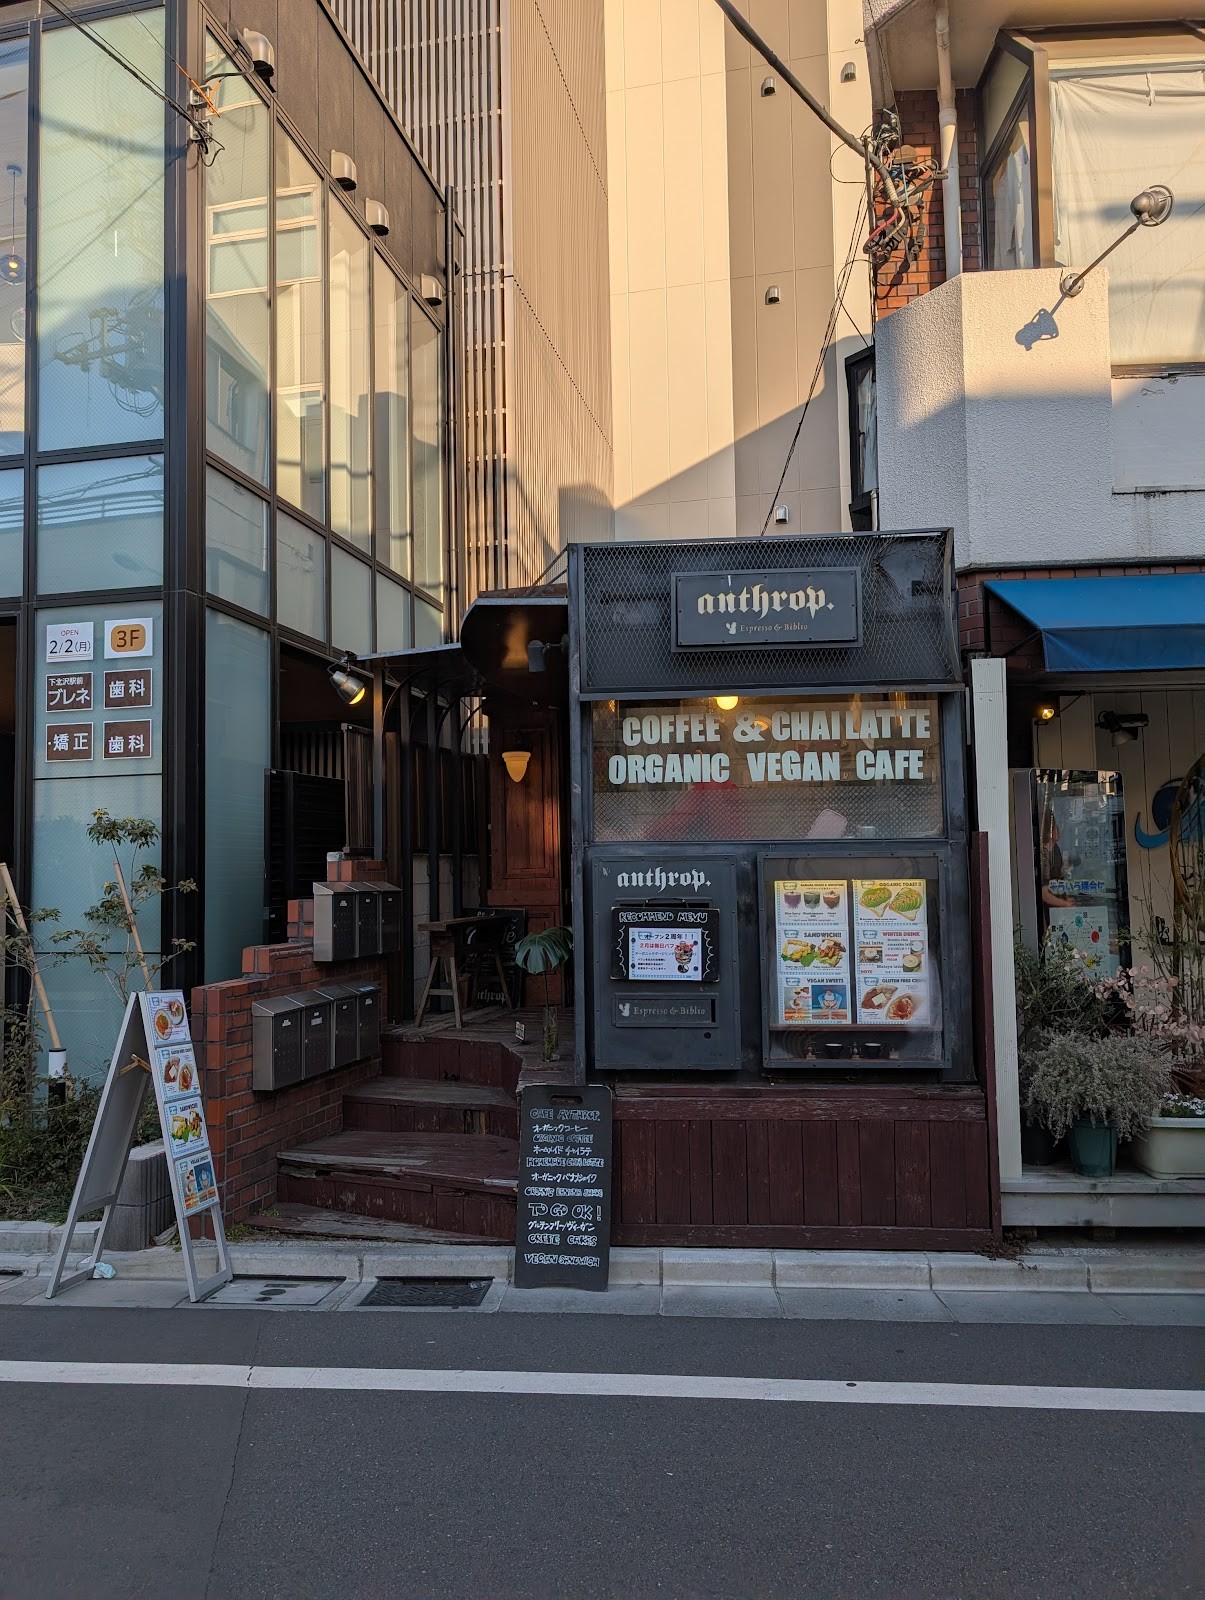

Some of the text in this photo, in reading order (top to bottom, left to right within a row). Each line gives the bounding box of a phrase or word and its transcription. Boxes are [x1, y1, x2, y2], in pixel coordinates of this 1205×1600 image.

[697, 583, 835, 621] anthrop.
[740, 624, 772, 632] Espresso
[784, 623, 808, 631] Biblio
[116, 629, 140, 648] 3F
[49, 639, 91, 654] 2/2(月)
[49, 677, 84, 686] 下北沢駅前
[109, 679, 145, 698] 歯科
[48, 688, 90, 706] ブレネ
[622, 708, 931, 747] COFFEE & CHAI LATTE
[109, 734, 145, 753] 歯科
[608, 749, 924, 784] ORGANIC VEGAN CAFE
[617, 866, 712, 893] anthrop.
[677, 912, 708, 923] MENU
[634, 1007, 668, 1016] Espresso
[680, 1007, 706, 1015] Biblio
[530, 1108, 553, 1120] CAFE
[532, 1124, 588, 1133] オーガニックコーヒー
[528, 1203, 548, 1216] TO
[550, 1203, 568, 1216] GO
[567, 1235, 597, 1247] CAKES
[524, 1253, 600, 1267] VEGAN SANDWICH
